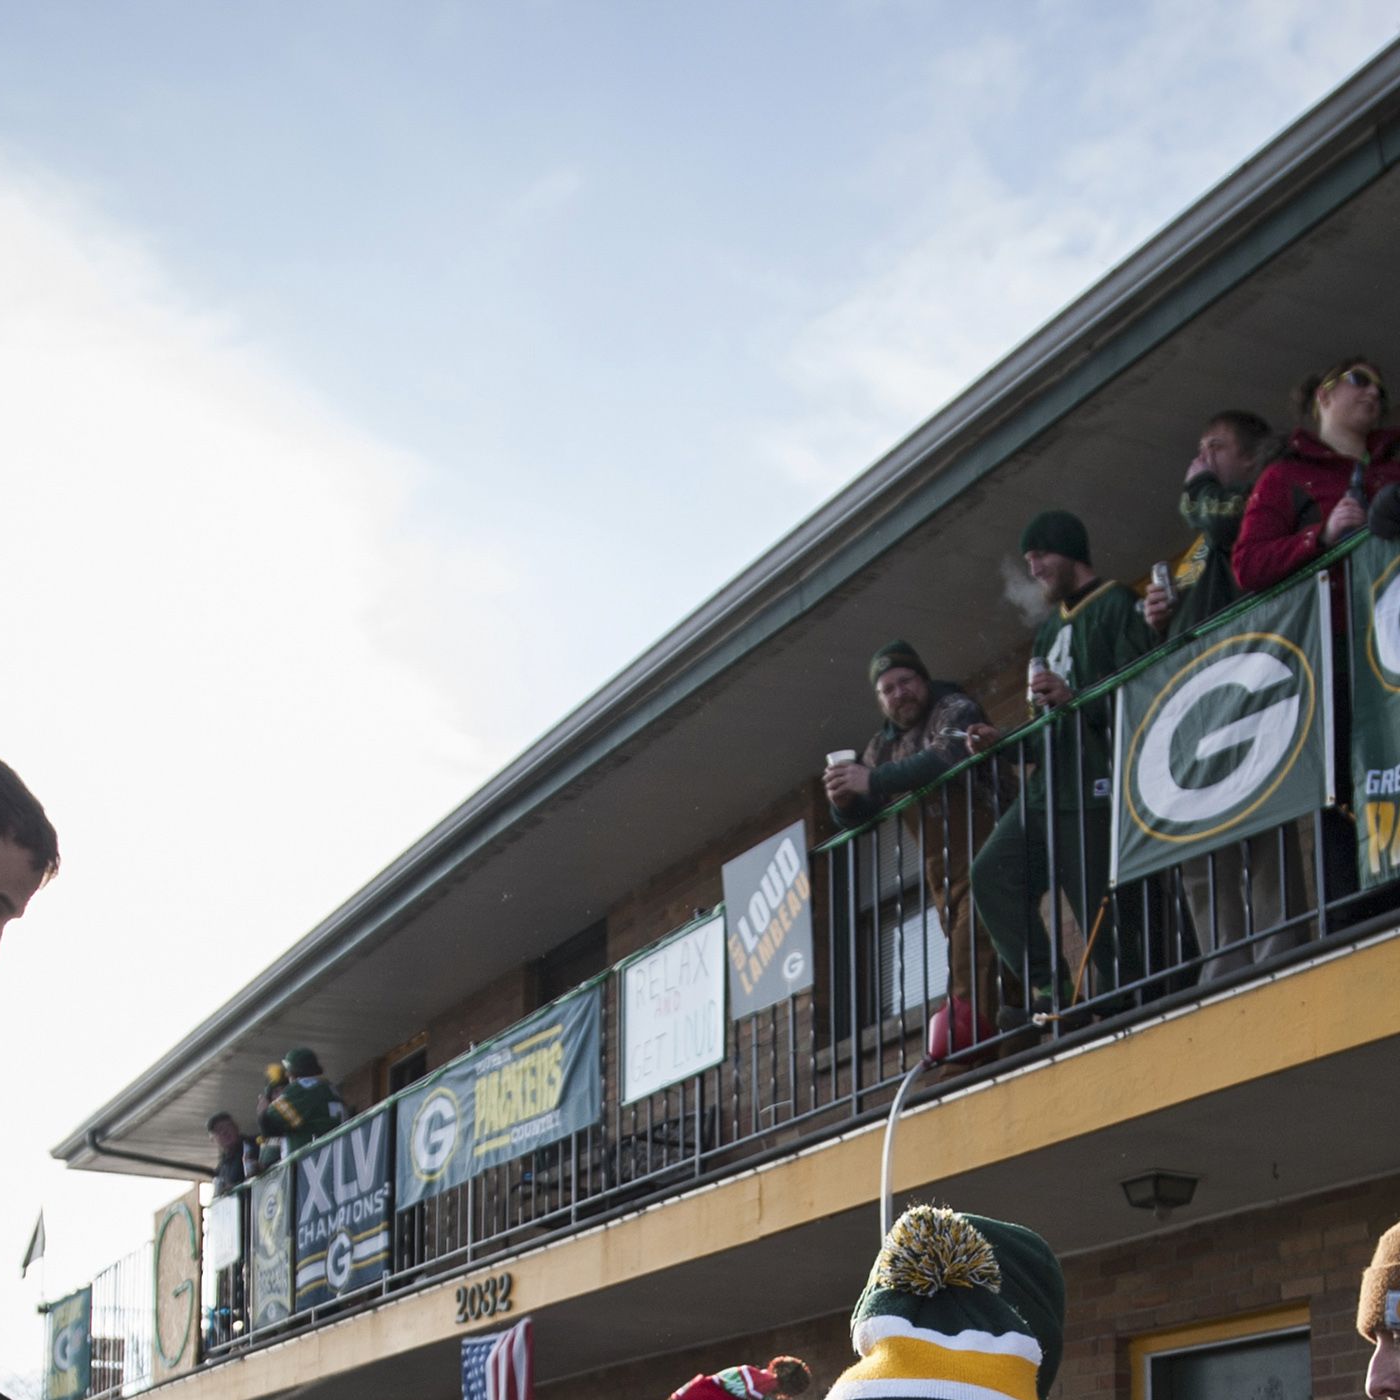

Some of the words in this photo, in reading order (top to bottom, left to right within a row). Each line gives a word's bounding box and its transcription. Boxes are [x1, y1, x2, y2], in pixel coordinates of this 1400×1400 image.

[1138, 652, 1299, 822] G
[737, 837, 800, 953] LOUD
[740, 872, 811, 993] LAMBEAU
[634, 931, 710, 1009] RELAX
[630, 1031, 668, 1083] GET
[672, 999, 718, 1069] LOUD
[474, 1041, 563, 1140] PACKERS
[511, 1111, 561, 1142] COUNTRY
[300, 1113, 385, 1221] XLV
[411, 1098, 457, 1173] G
[299, 1192, 385, 1248] CHAMPIONS
[326, 1232, 352, 1288] G
[455, 1273, 513, 1323] 2032
